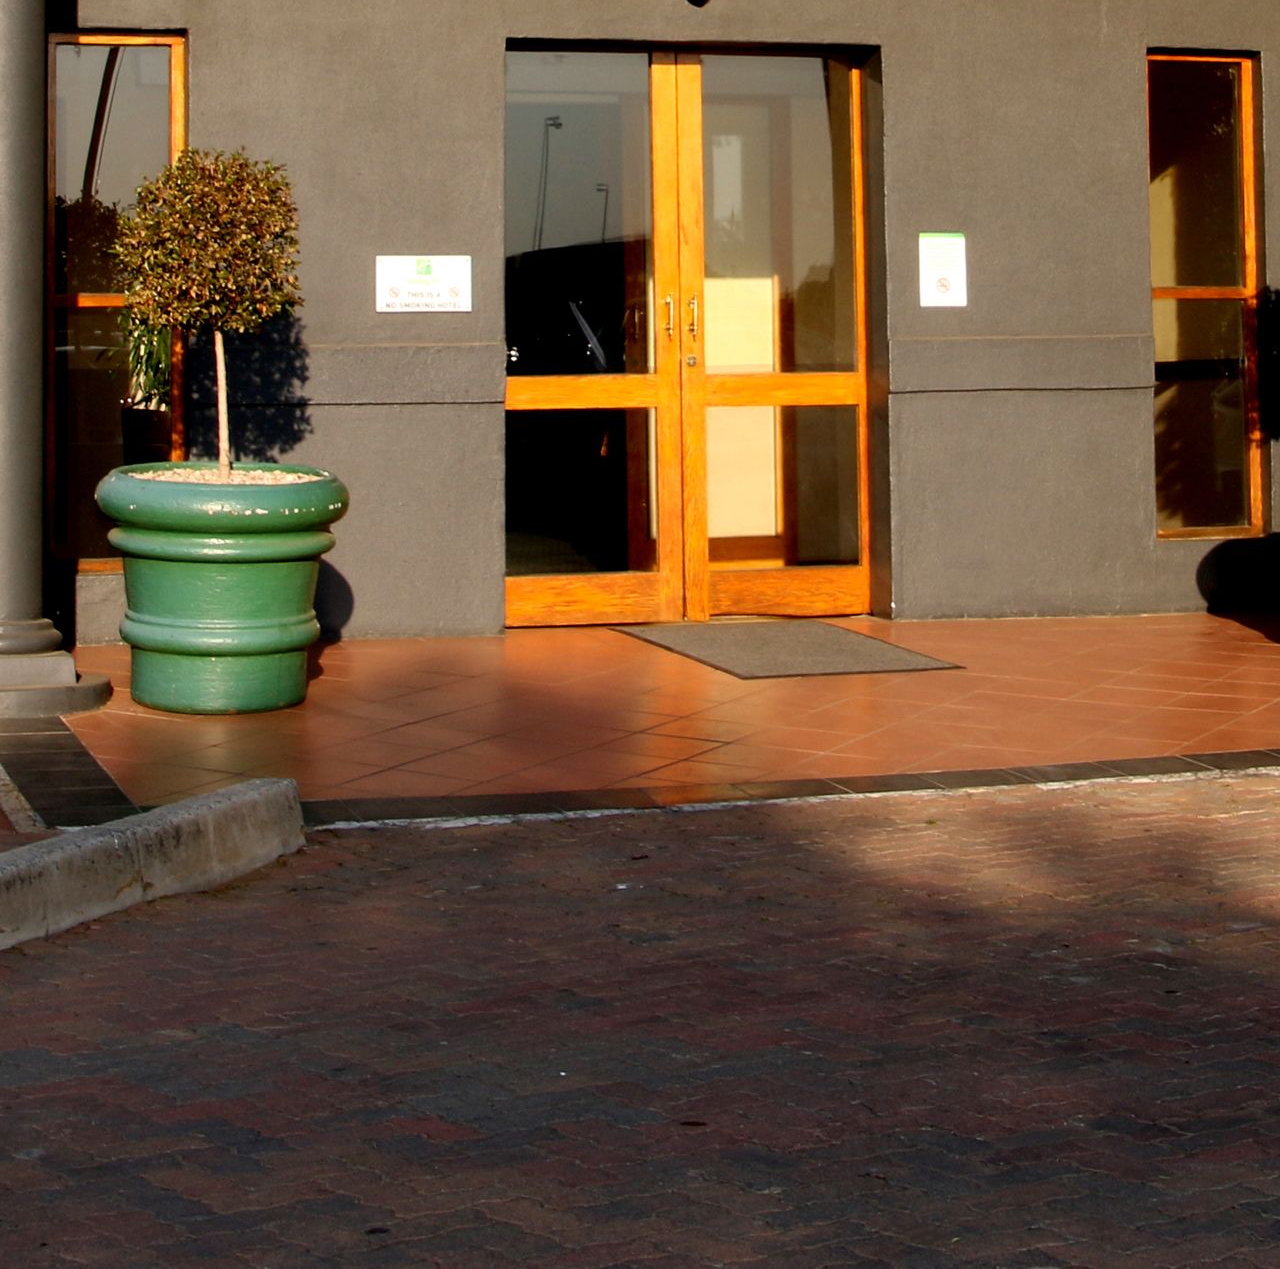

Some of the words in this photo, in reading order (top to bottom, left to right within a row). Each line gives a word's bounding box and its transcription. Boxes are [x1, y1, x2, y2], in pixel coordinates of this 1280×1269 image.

[407, 291, 424, 299] THIS
[426, 291, 434, 299] IS
[385, 301, 397, 309] NO
[399, 301, 435, 309] SMOKING
